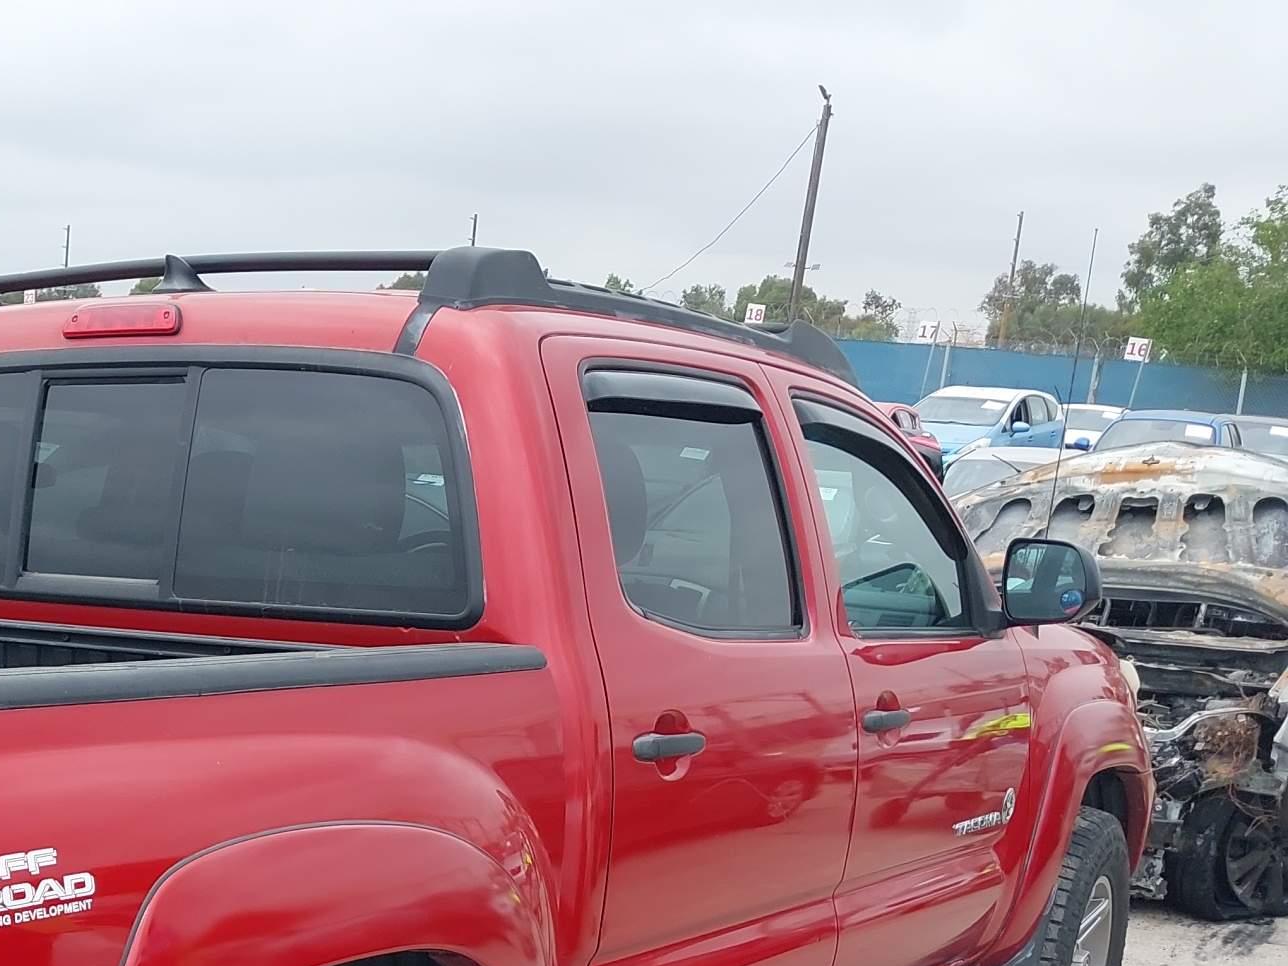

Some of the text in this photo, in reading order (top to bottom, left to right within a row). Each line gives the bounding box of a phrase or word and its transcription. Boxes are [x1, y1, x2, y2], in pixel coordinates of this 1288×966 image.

[747, 308, 763, 321] 18
[918, 325, 937, 339] 17
[1127, 342, 1148, 357] 16
[14, 899, 93, 926] DEVELOPMENT
